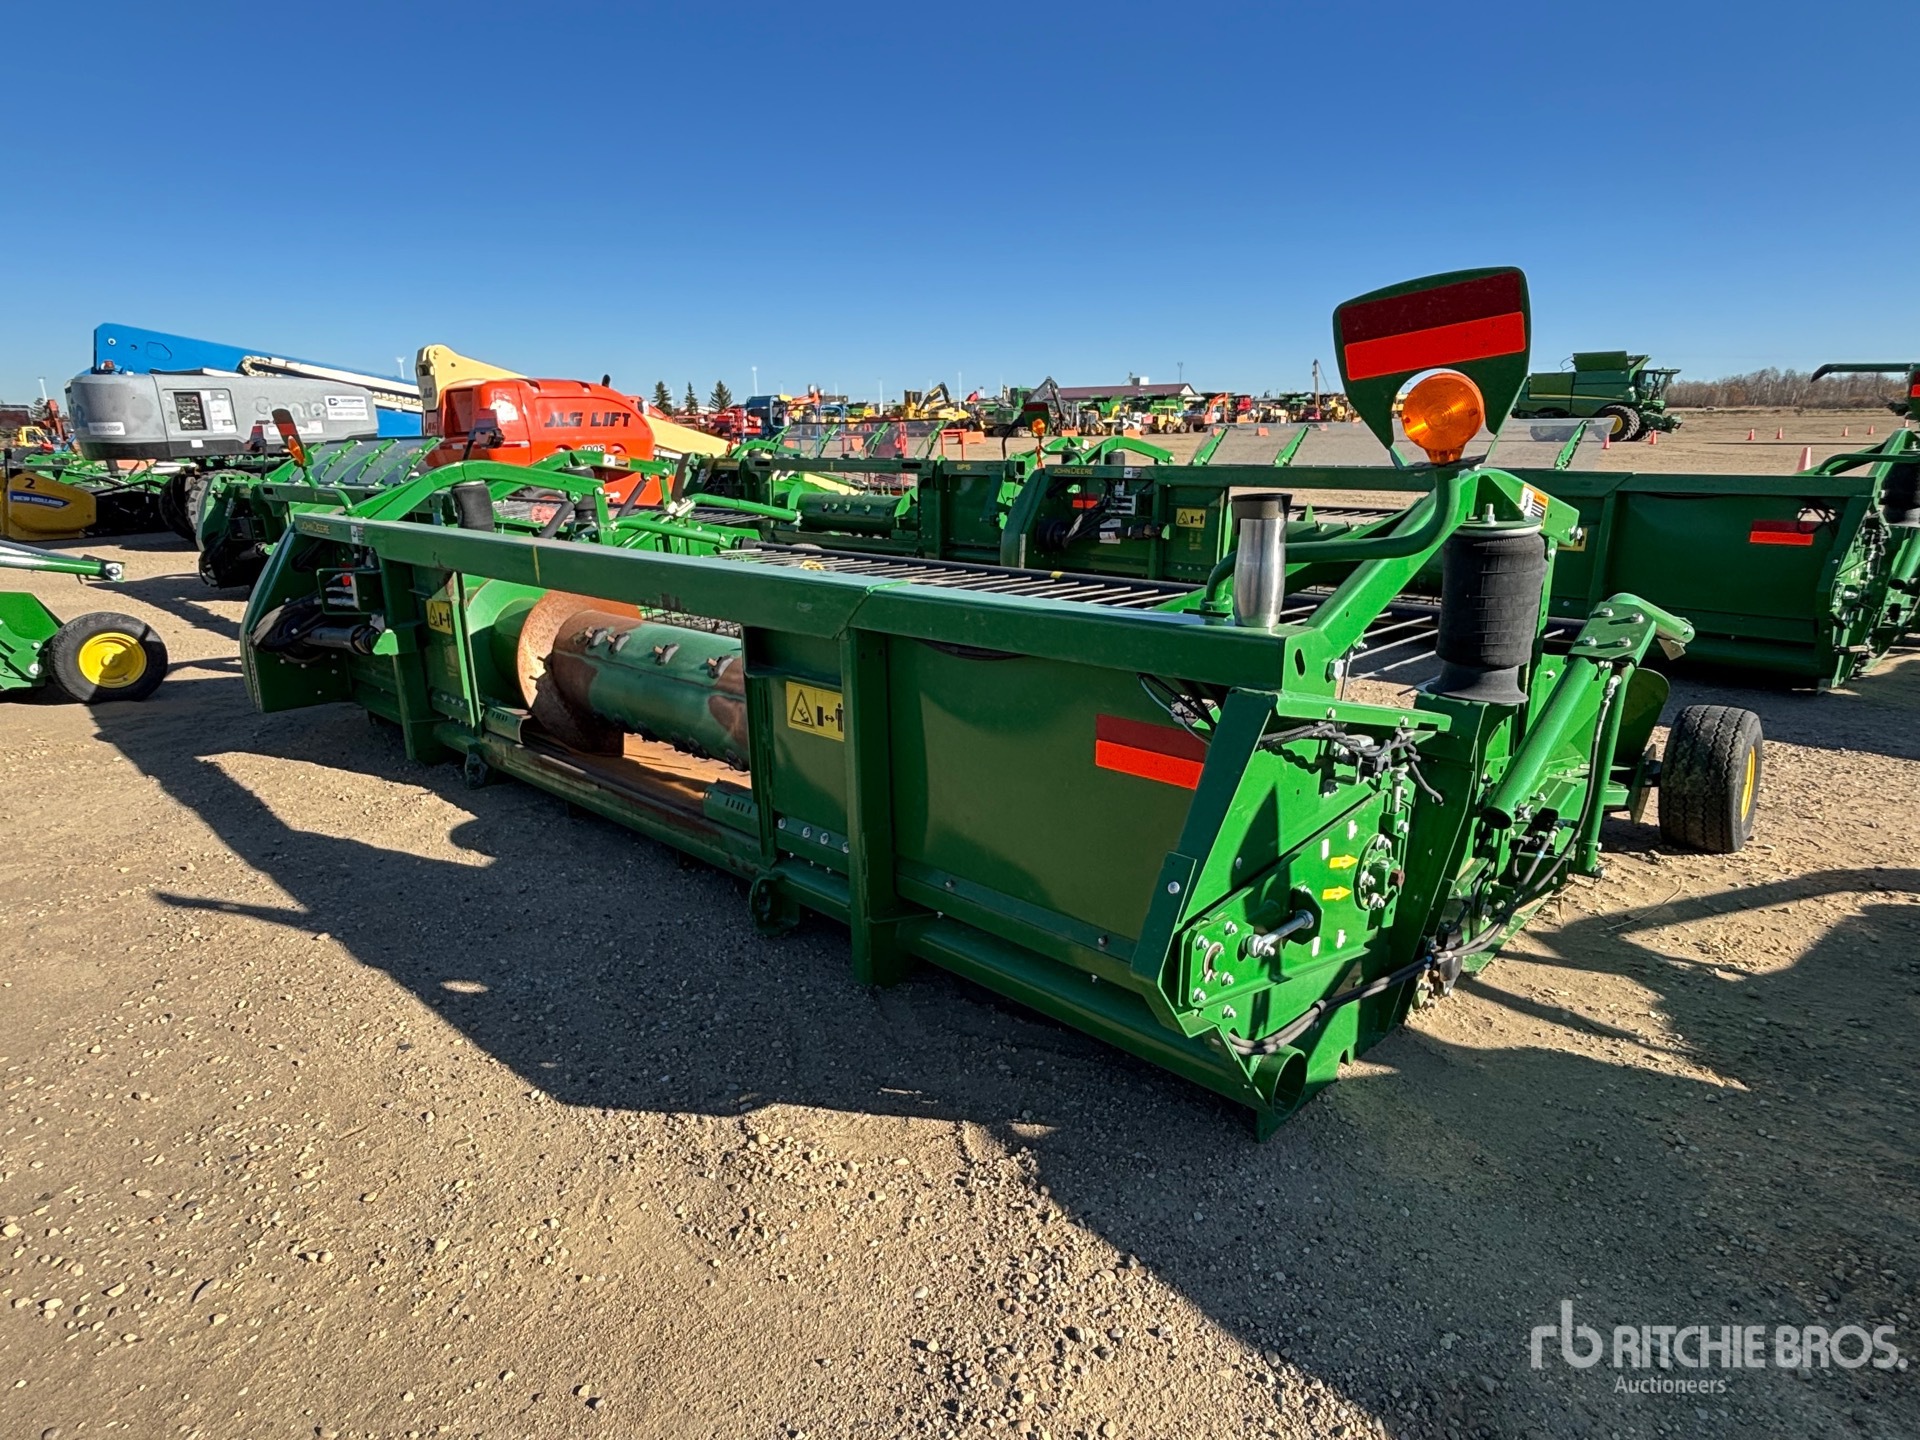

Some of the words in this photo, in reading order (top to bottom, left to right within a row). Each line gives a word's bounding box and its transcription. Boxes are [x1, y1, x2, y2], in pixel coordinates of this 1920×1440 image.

[544, 412, 583, 427] JLG
[590, 412, 631, 427] LIFT
[25, 478, 35, 489] 2
[31, 497, 64, 507] HOLLAND
